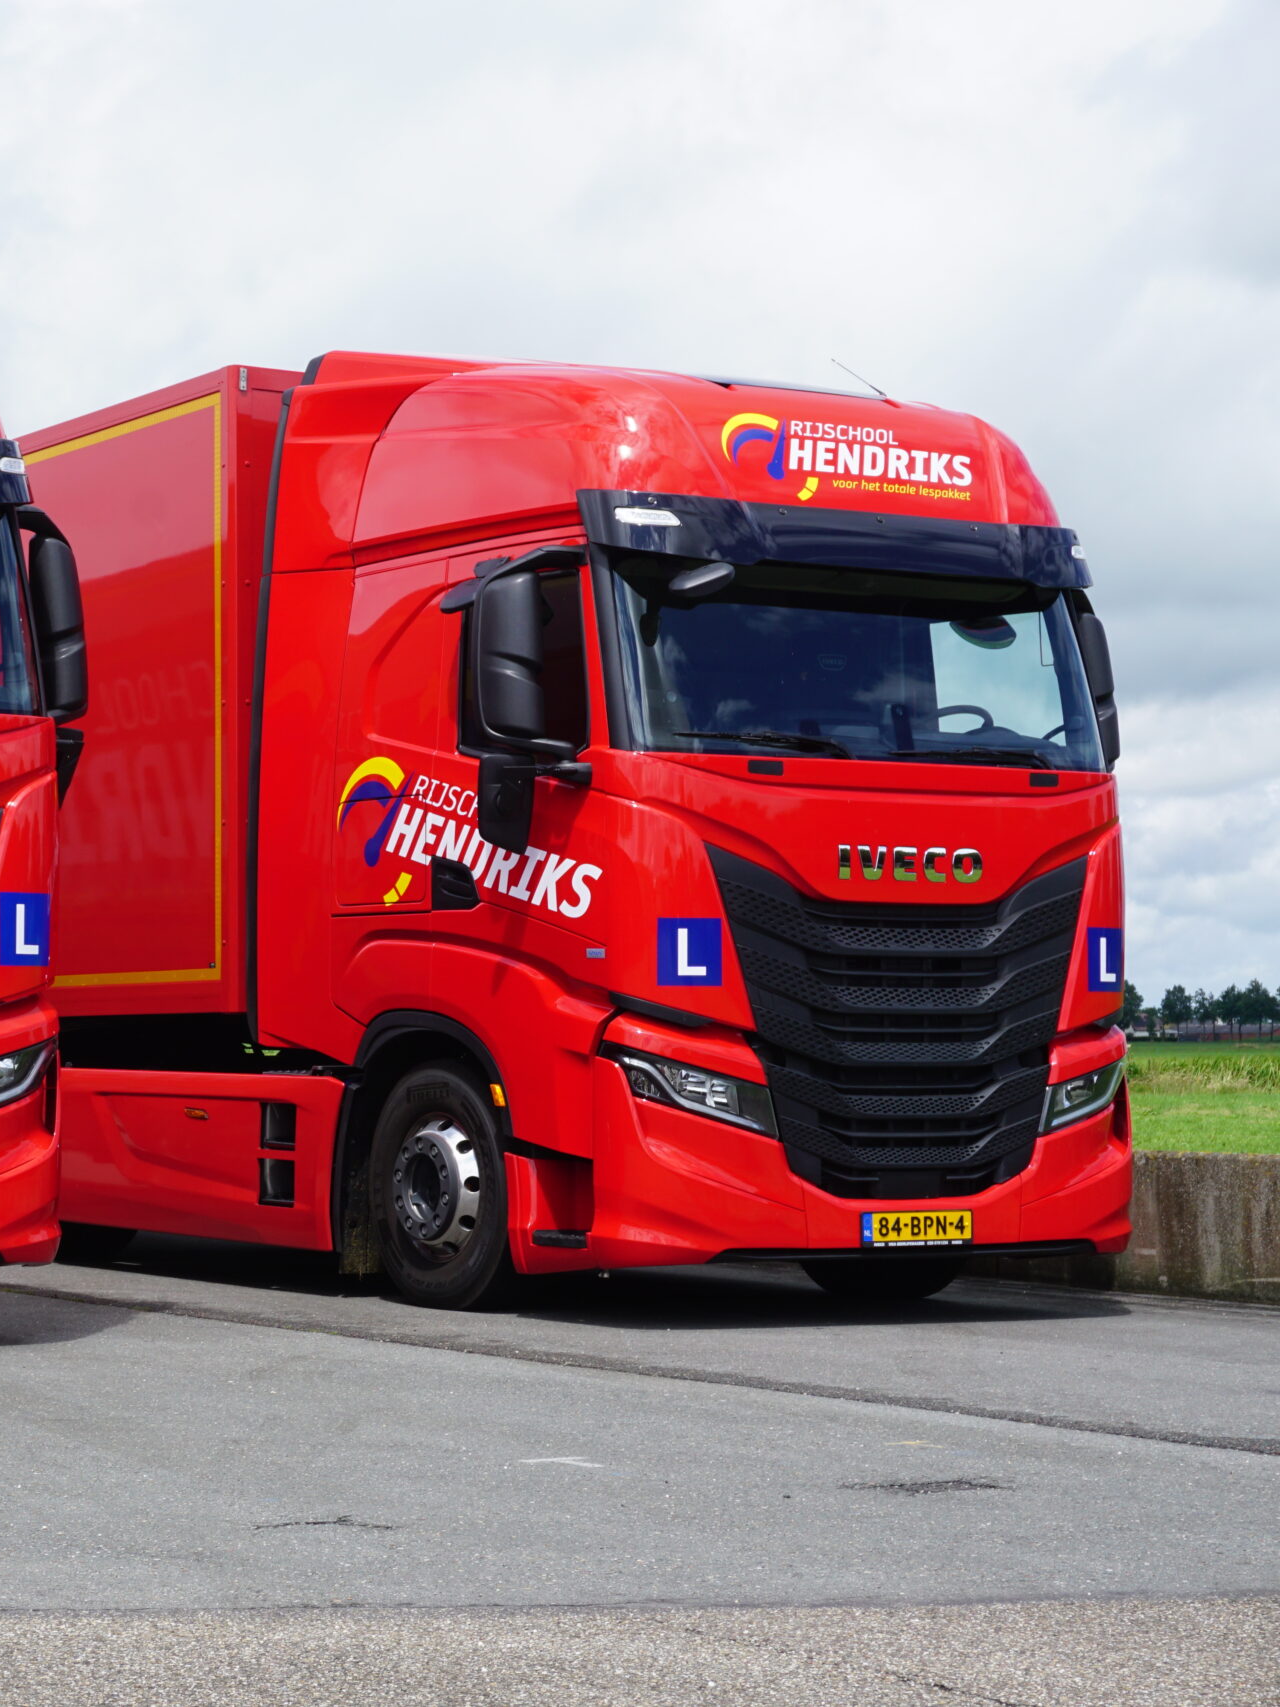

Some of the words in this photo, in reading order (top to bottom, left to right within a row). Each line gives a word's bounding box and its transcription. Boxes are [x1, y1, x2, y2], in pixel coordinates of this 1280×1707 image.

[790, 420, 899, 445] RIJSCHOOL
[788, 438, 973, 487] HENDRIKS
[832, 479, 859, 489] voor
[861, 478, 881, 492] het
[882, 481, 917, 495] totale
[918, 485, 972, 501] lespakket
[410, 774, 479, 818] RIJSC
[385, 803, 603, 919] HENDRIKS
[838, 844, 983, 883] IVECO
[15, 903, 39, 955] L
[677, 928, 707, 976] L
[1100, 937, 1116, 982] L
[878, 1215, 966, 1237] 84-BPN-4
